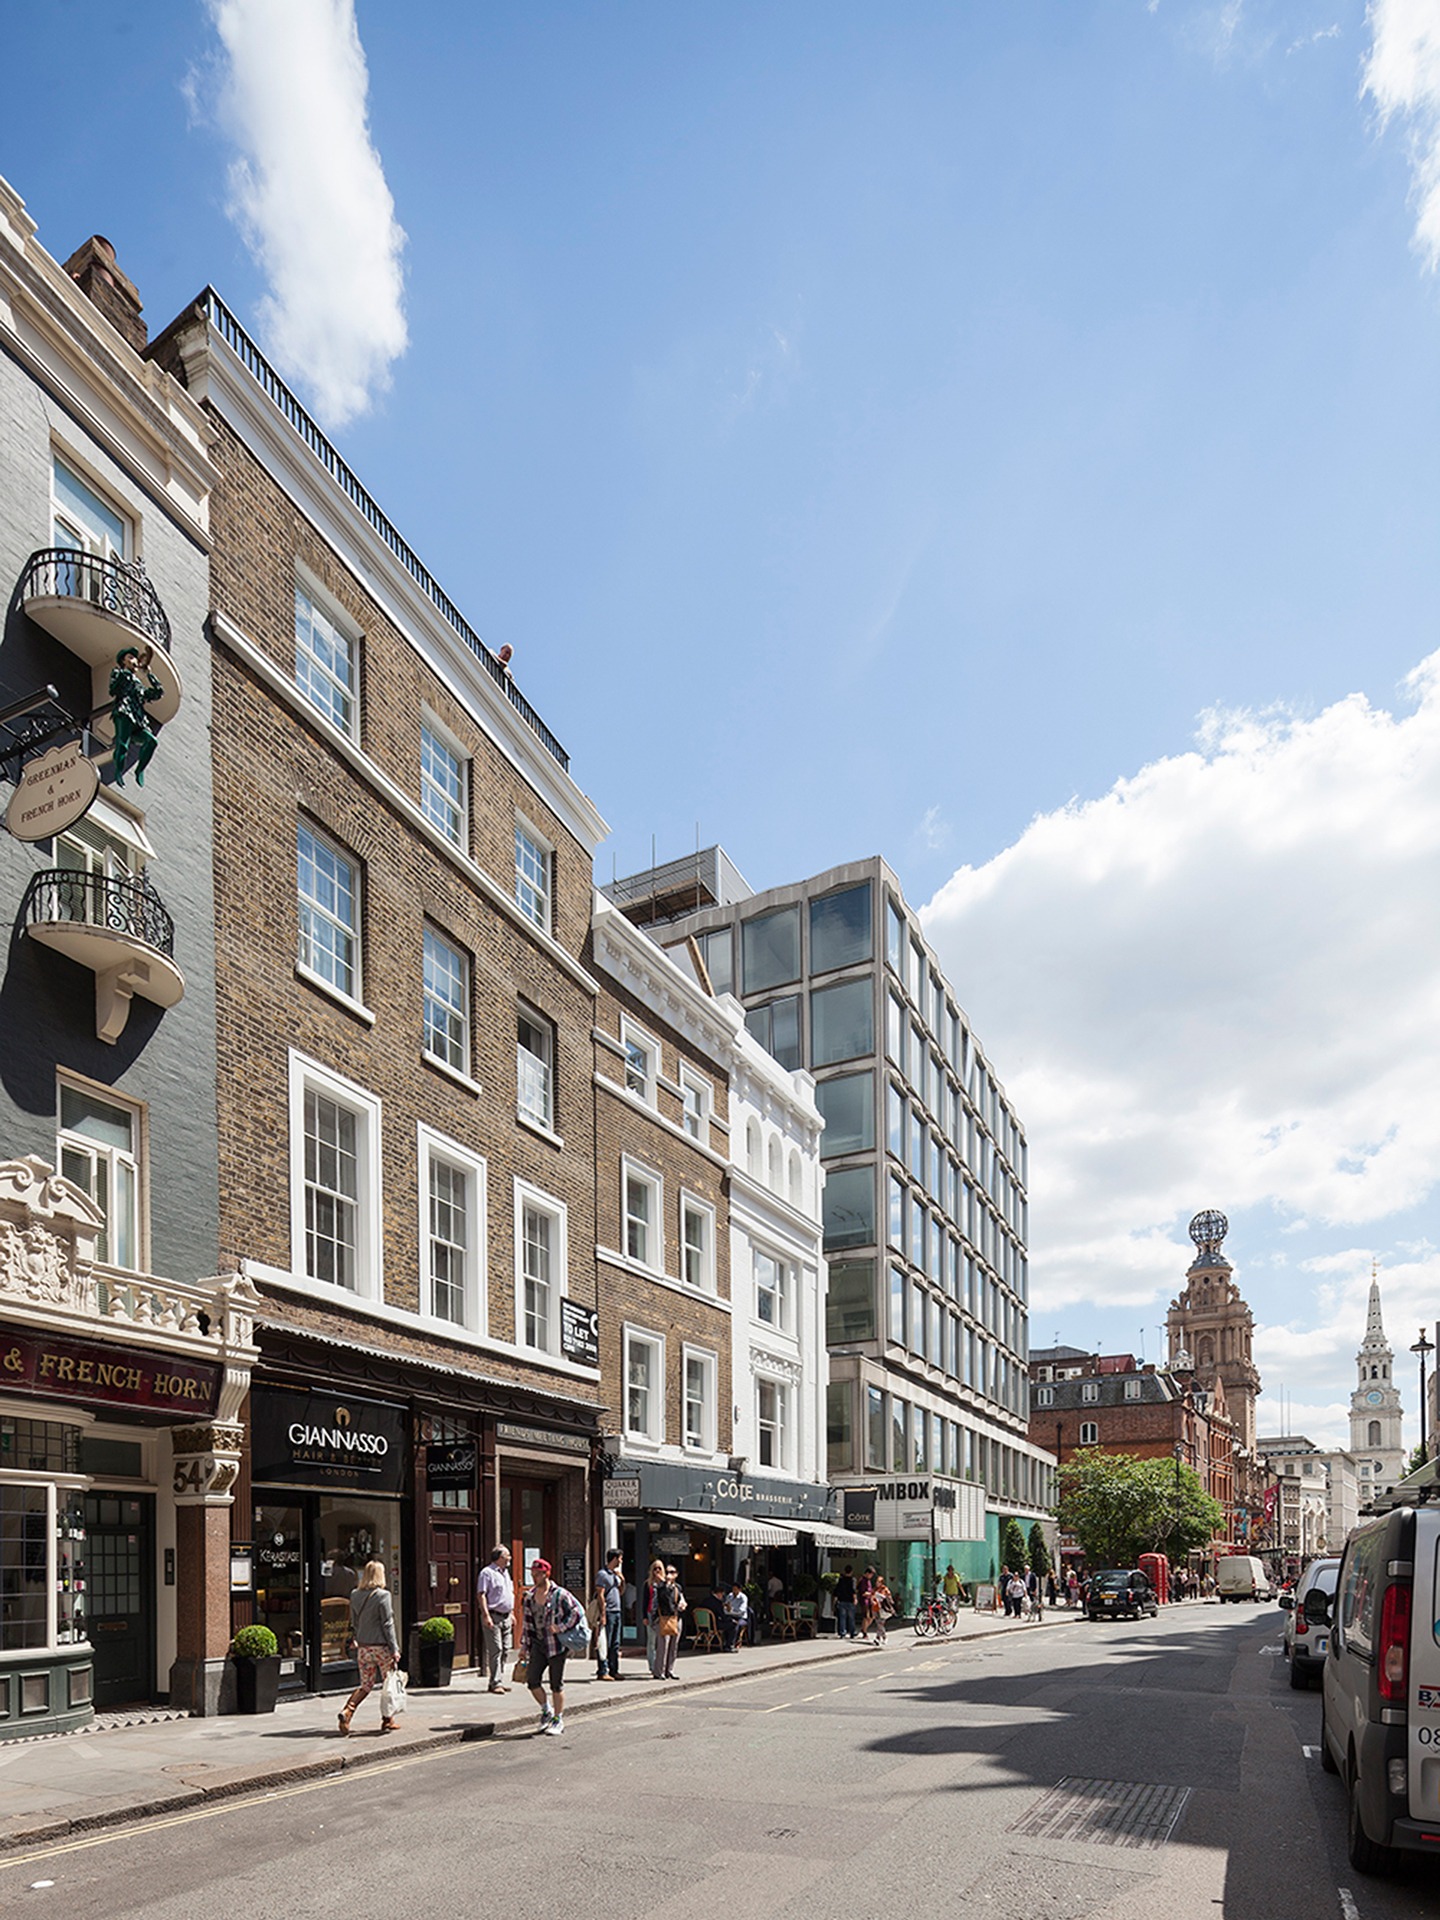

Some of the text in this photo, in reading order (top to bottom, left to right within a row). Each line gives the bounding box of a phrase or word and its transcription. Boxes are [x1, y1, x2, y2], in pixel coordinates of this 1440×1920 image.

[26, 756, 77, 786] GREENMAN
[21, 789, 81, 823] FRENCH HORN
[574, 1326, 590, 1341] LET
[3, 1347, 213, 1401] & FRENCH HORN
[288, 1423, 389, 1456] GIANNASSO
[293, 1450, 324, 1461] HAIR
[173, 1461, 203, 1493] 54
[321, 1468, 359, 1478] LONDON
[604, 1489, 639, 1498] MEETING
[605, 1481, 637, 1489] QUAKER
[717, 1477, 793, 1504] CÔTE BRASSERIE
[607, 1499, 635, 1507] HOUSE
